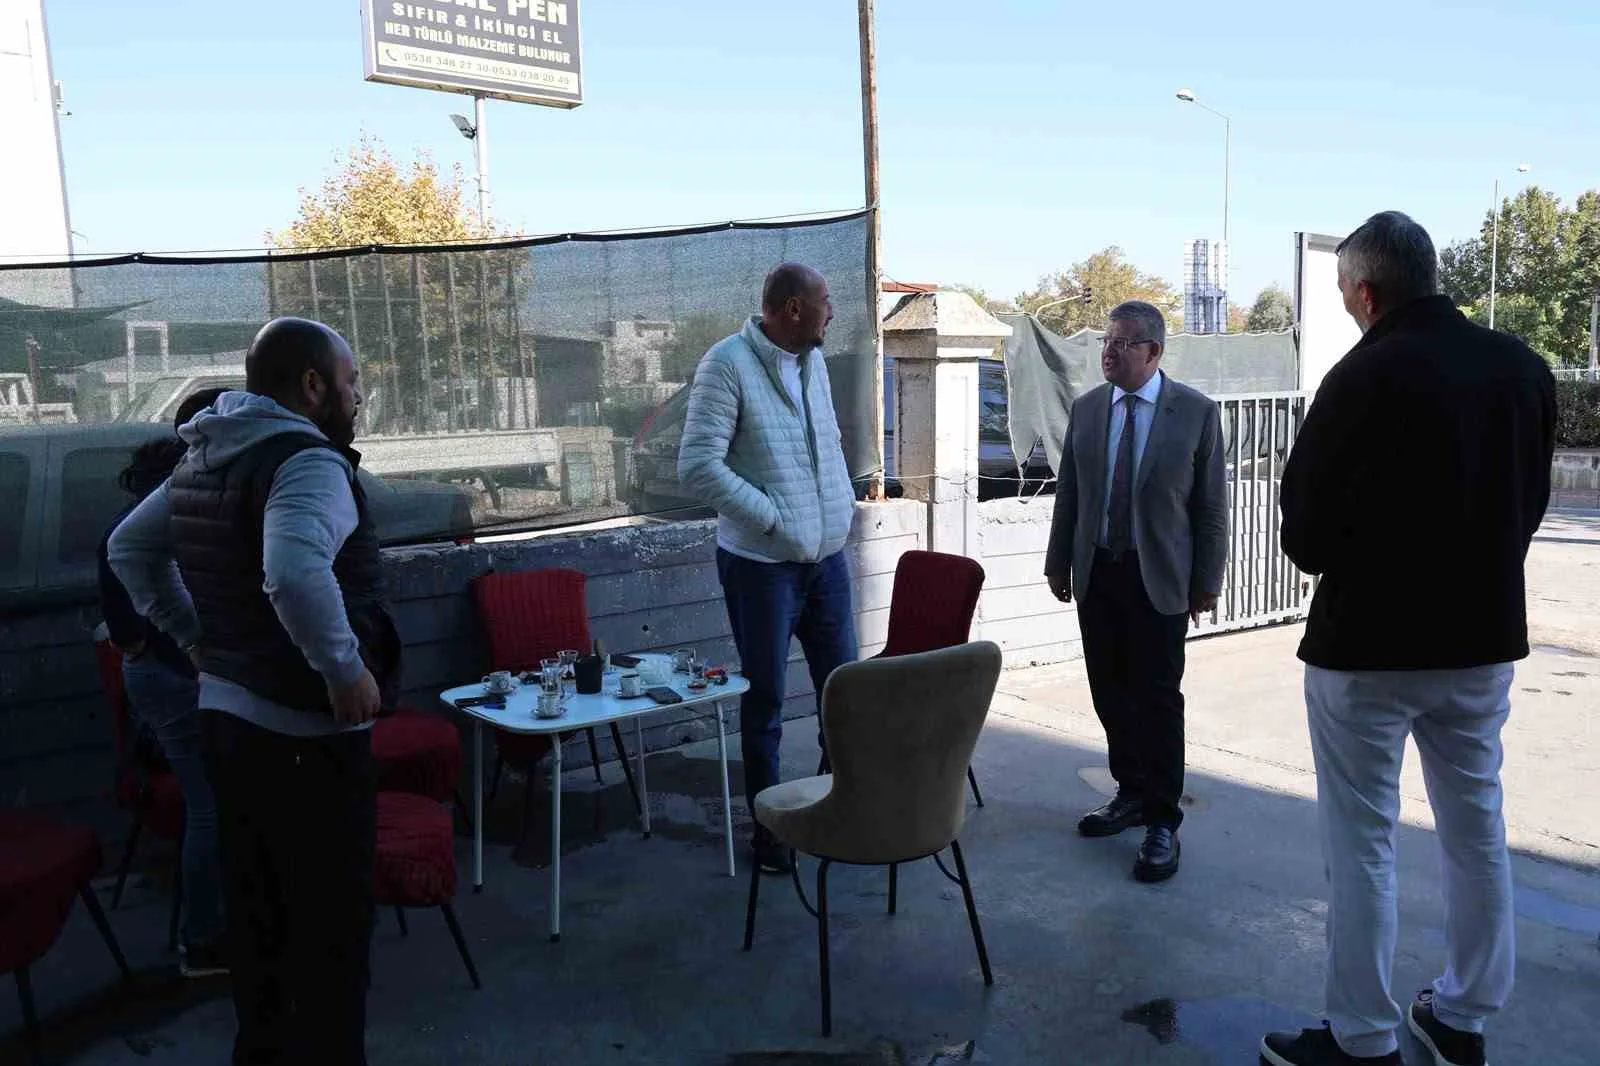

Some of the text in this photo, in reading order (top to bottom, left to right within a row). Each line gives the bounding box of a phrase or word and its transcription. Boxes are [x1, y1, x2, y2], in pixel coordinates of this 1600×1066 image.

[392, 2, 449, 24] SIFIR
[455, 14, 467, 28] &
[542, 29, 563, 44] EL
[507, 0, 568, 25] PEN
[384, 21, 410, 37] HER
[456, 32, 516, 56] MALZEME
[519, 44, 571, 64] BULUNUR
